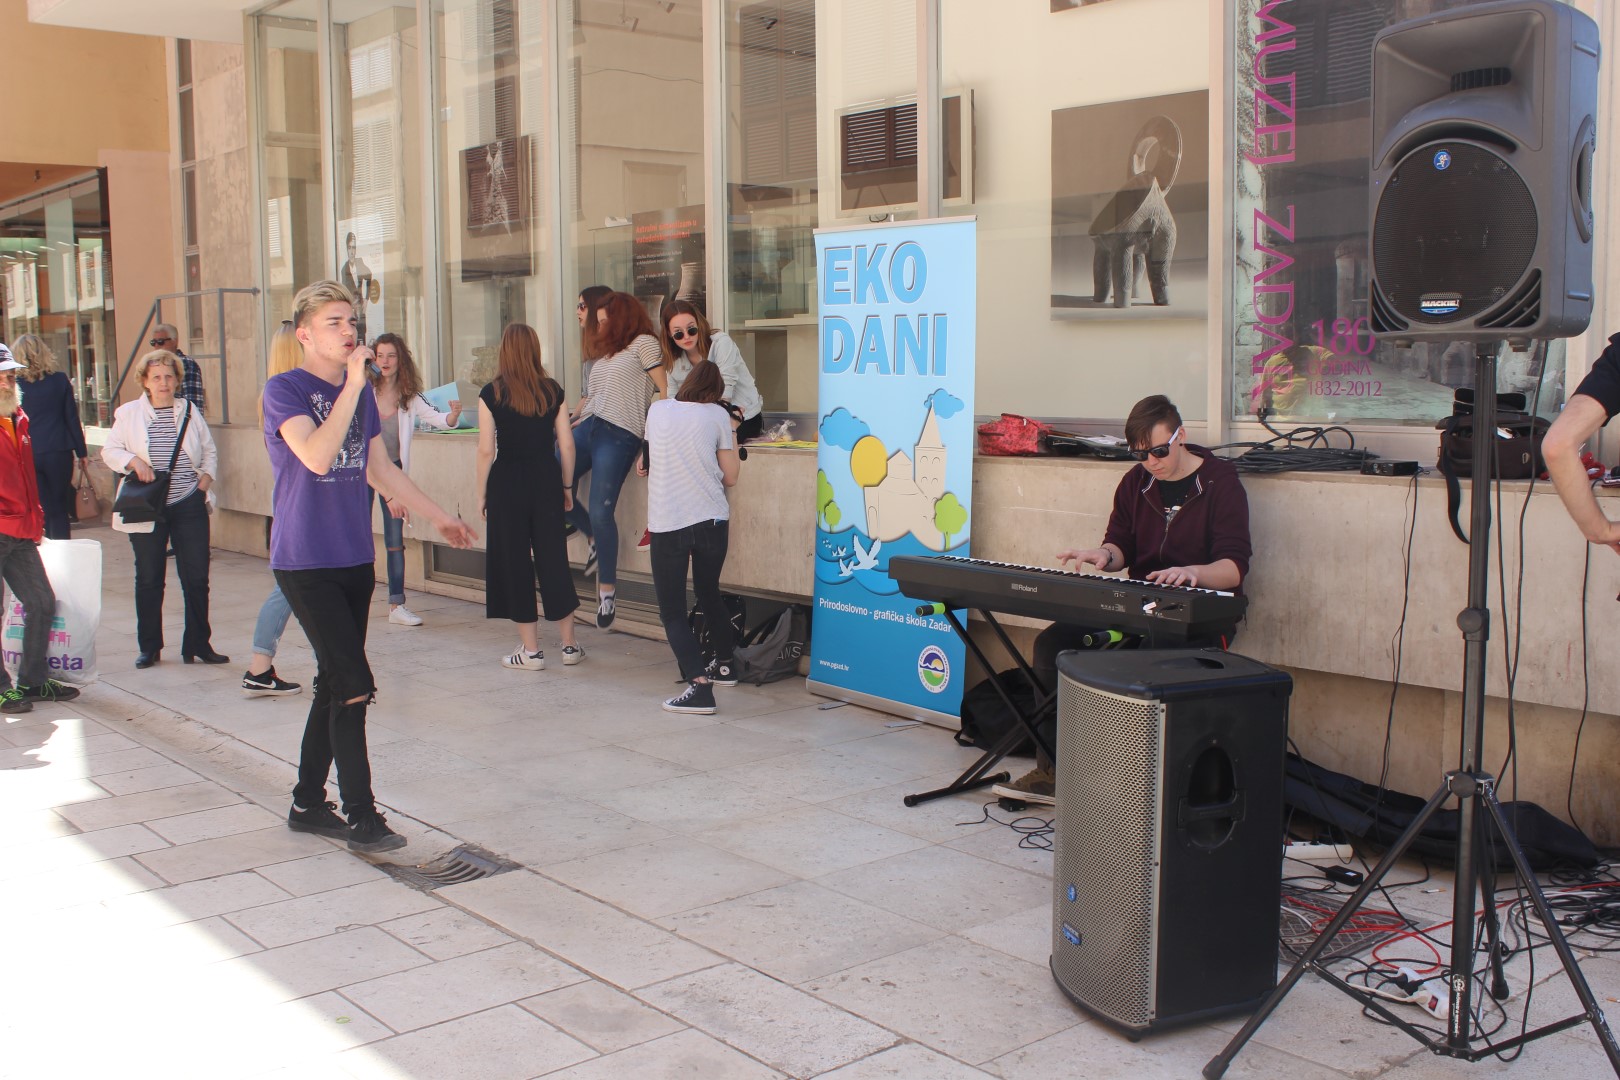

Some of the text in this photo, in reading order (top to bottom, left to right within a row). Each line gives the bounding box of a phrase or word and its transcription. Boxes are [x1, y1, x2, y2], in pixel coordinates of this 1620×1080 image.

[823, 240, 928, 305] EKO
[823, 313, 949, 377] DANI
[1311, 316, 1377, 356] 180
[1307, 359, 1372, 376] GODINA
[1307, 380, 1382, 397] 1832-2012
[1018, 584, 1038, 593] Roland
[819, 597, 868, 616] Prirodoslovno
[873, 609, 904, 623] grafička
[905, 613, 927, 628] škola
[928, 618, 952, 633] Zadar
